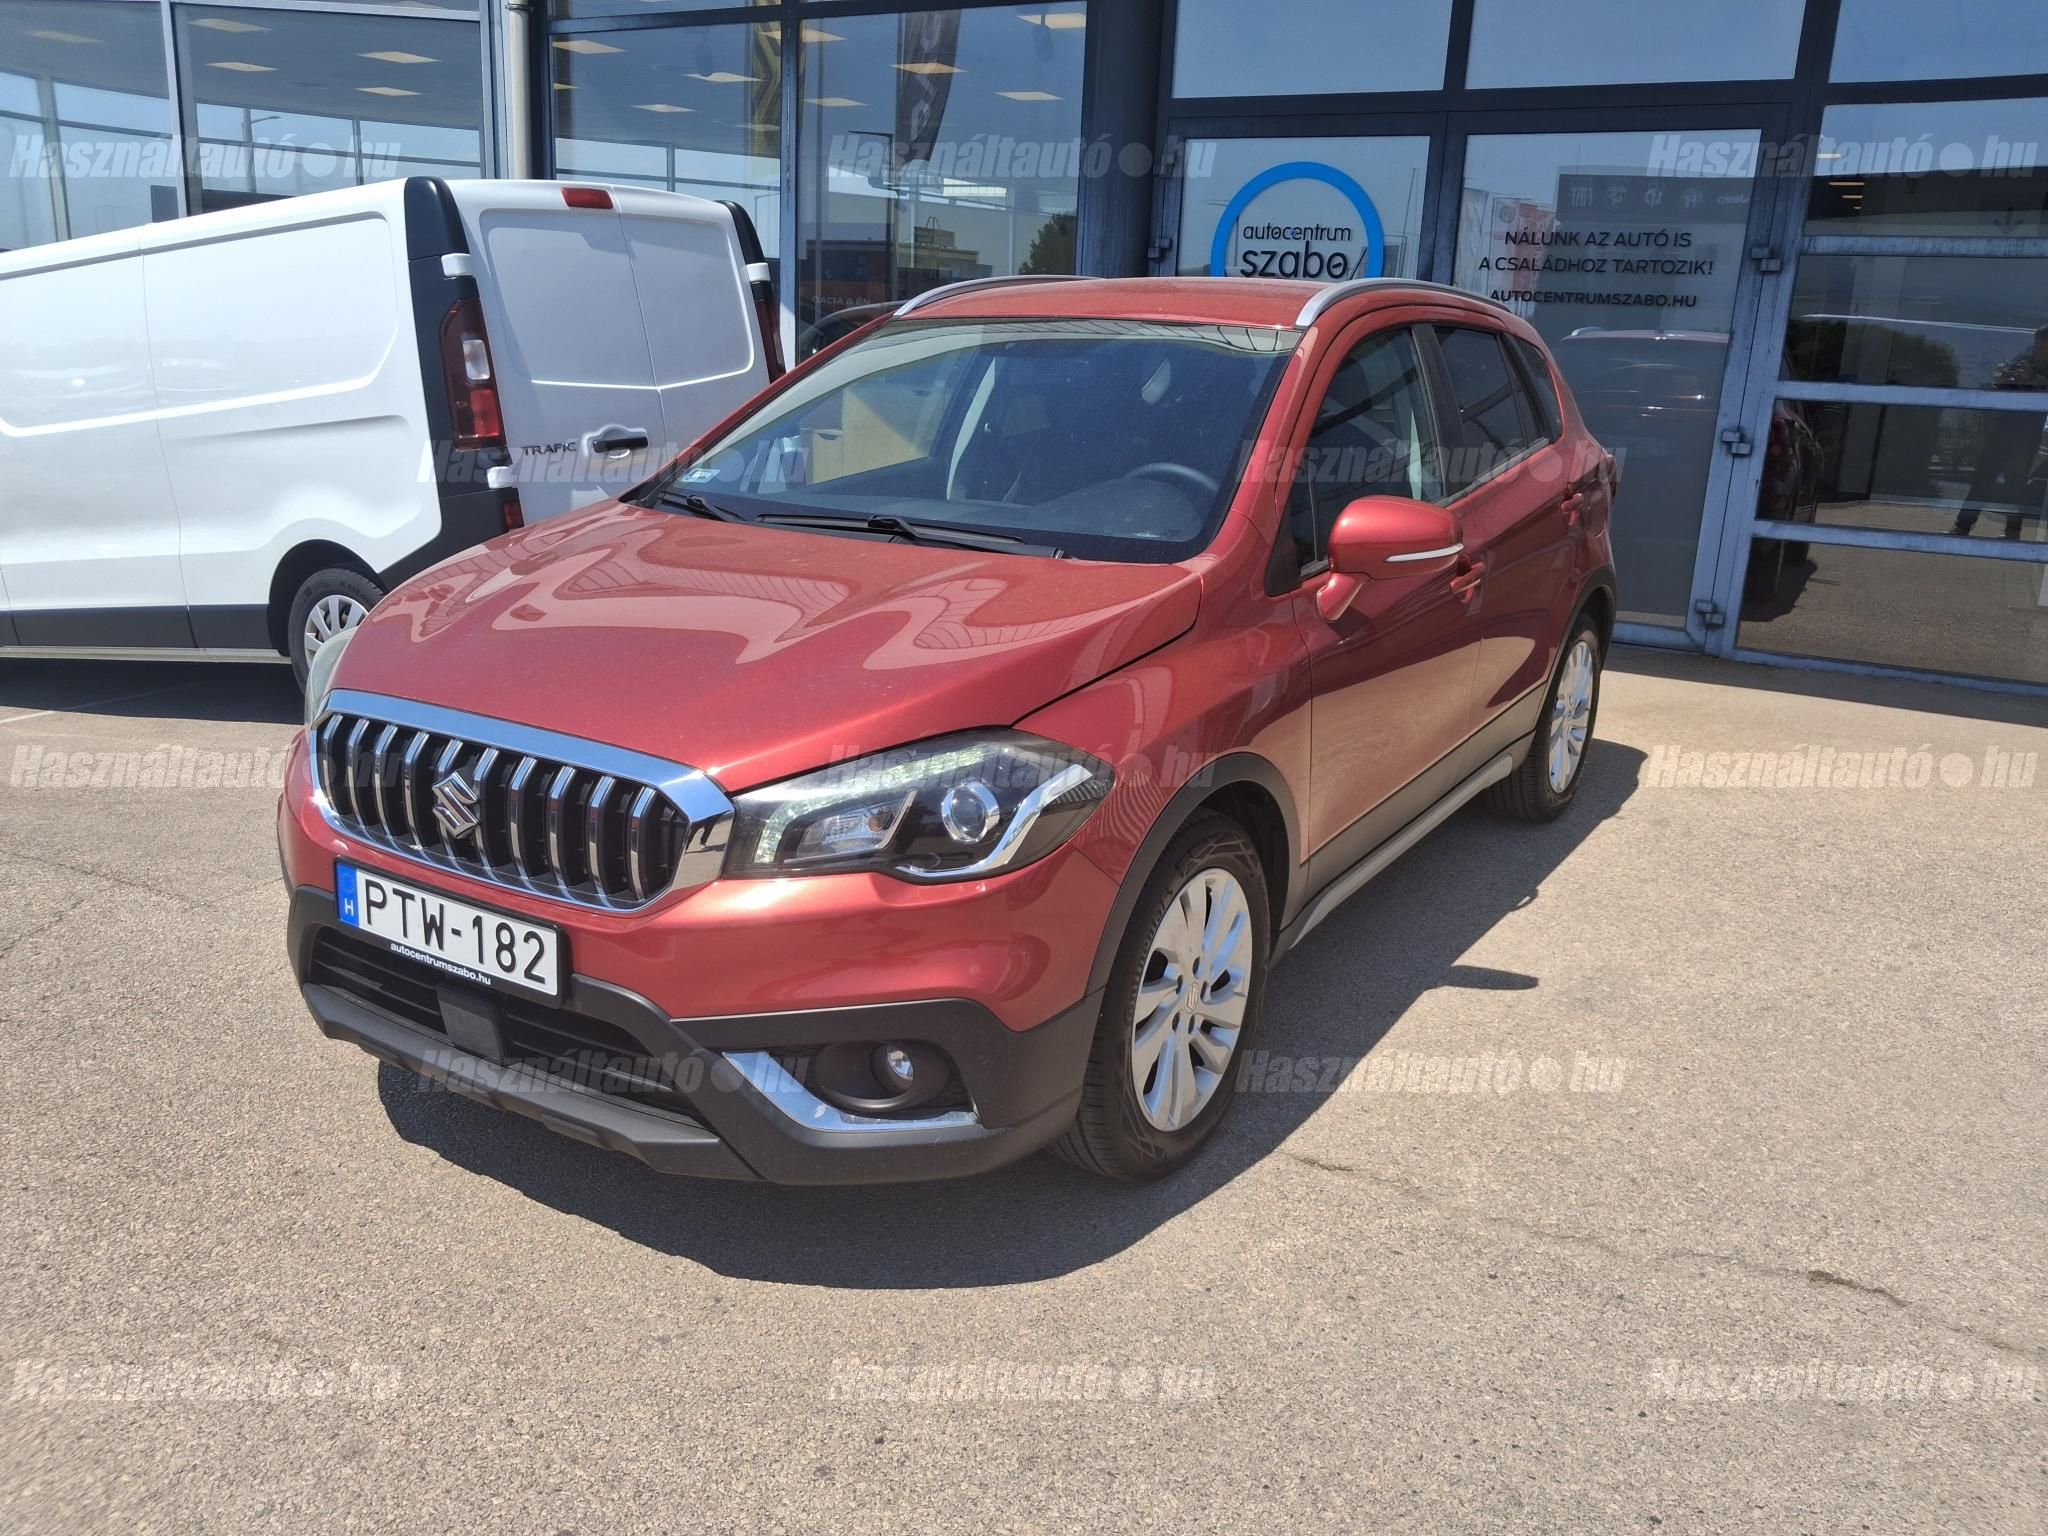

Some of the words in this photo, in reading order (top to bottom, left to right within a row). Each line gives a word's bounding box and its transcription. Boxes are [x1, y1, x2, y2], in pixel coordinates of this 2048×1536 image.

[1243, 222, 1352, 242] autocentrum
[1504, 227, 1580, 247] NÁLUNK
[1584, 231, 1610, 247] AZ
[1613, 228, 1669, 248] AUTÓ
[1673, 232, 1692, 248] IS
[1478, 256, 1491, 271] A
[1494, 254, 1608, 274] CSALÁDHOZ
[1612, 258, 1714, 276] TARTOZIK!
[1489, 288, 1698, 308] AUTOCENTRUMSZABO.HU
[520, 441, 577, 456] TRAFIC
[343, 898, 355, 916] H
[364, 878, 547, 985] PTW-182
[389, 941, 492, 987] autocentrumszabo.hu
